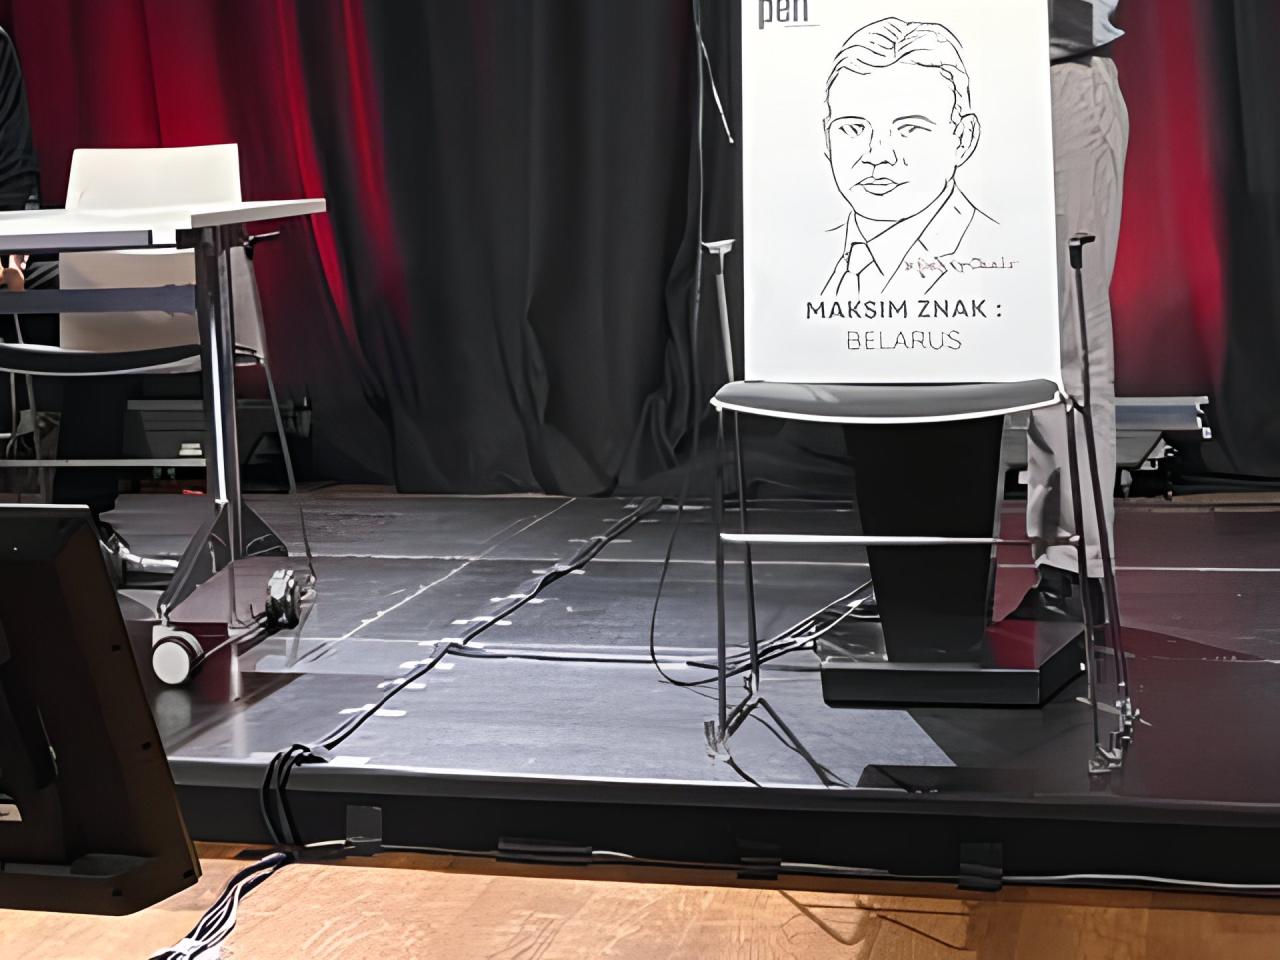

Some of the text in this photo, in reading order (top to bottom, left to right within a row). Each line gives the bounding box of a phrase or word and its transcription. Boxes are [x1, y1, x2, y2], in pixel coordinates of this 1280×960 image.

[806, 299, 908, 320] MAKSIM
[917, 298, 988, 319] ZNAK
[847, 329, 962, 351] BELARUS
